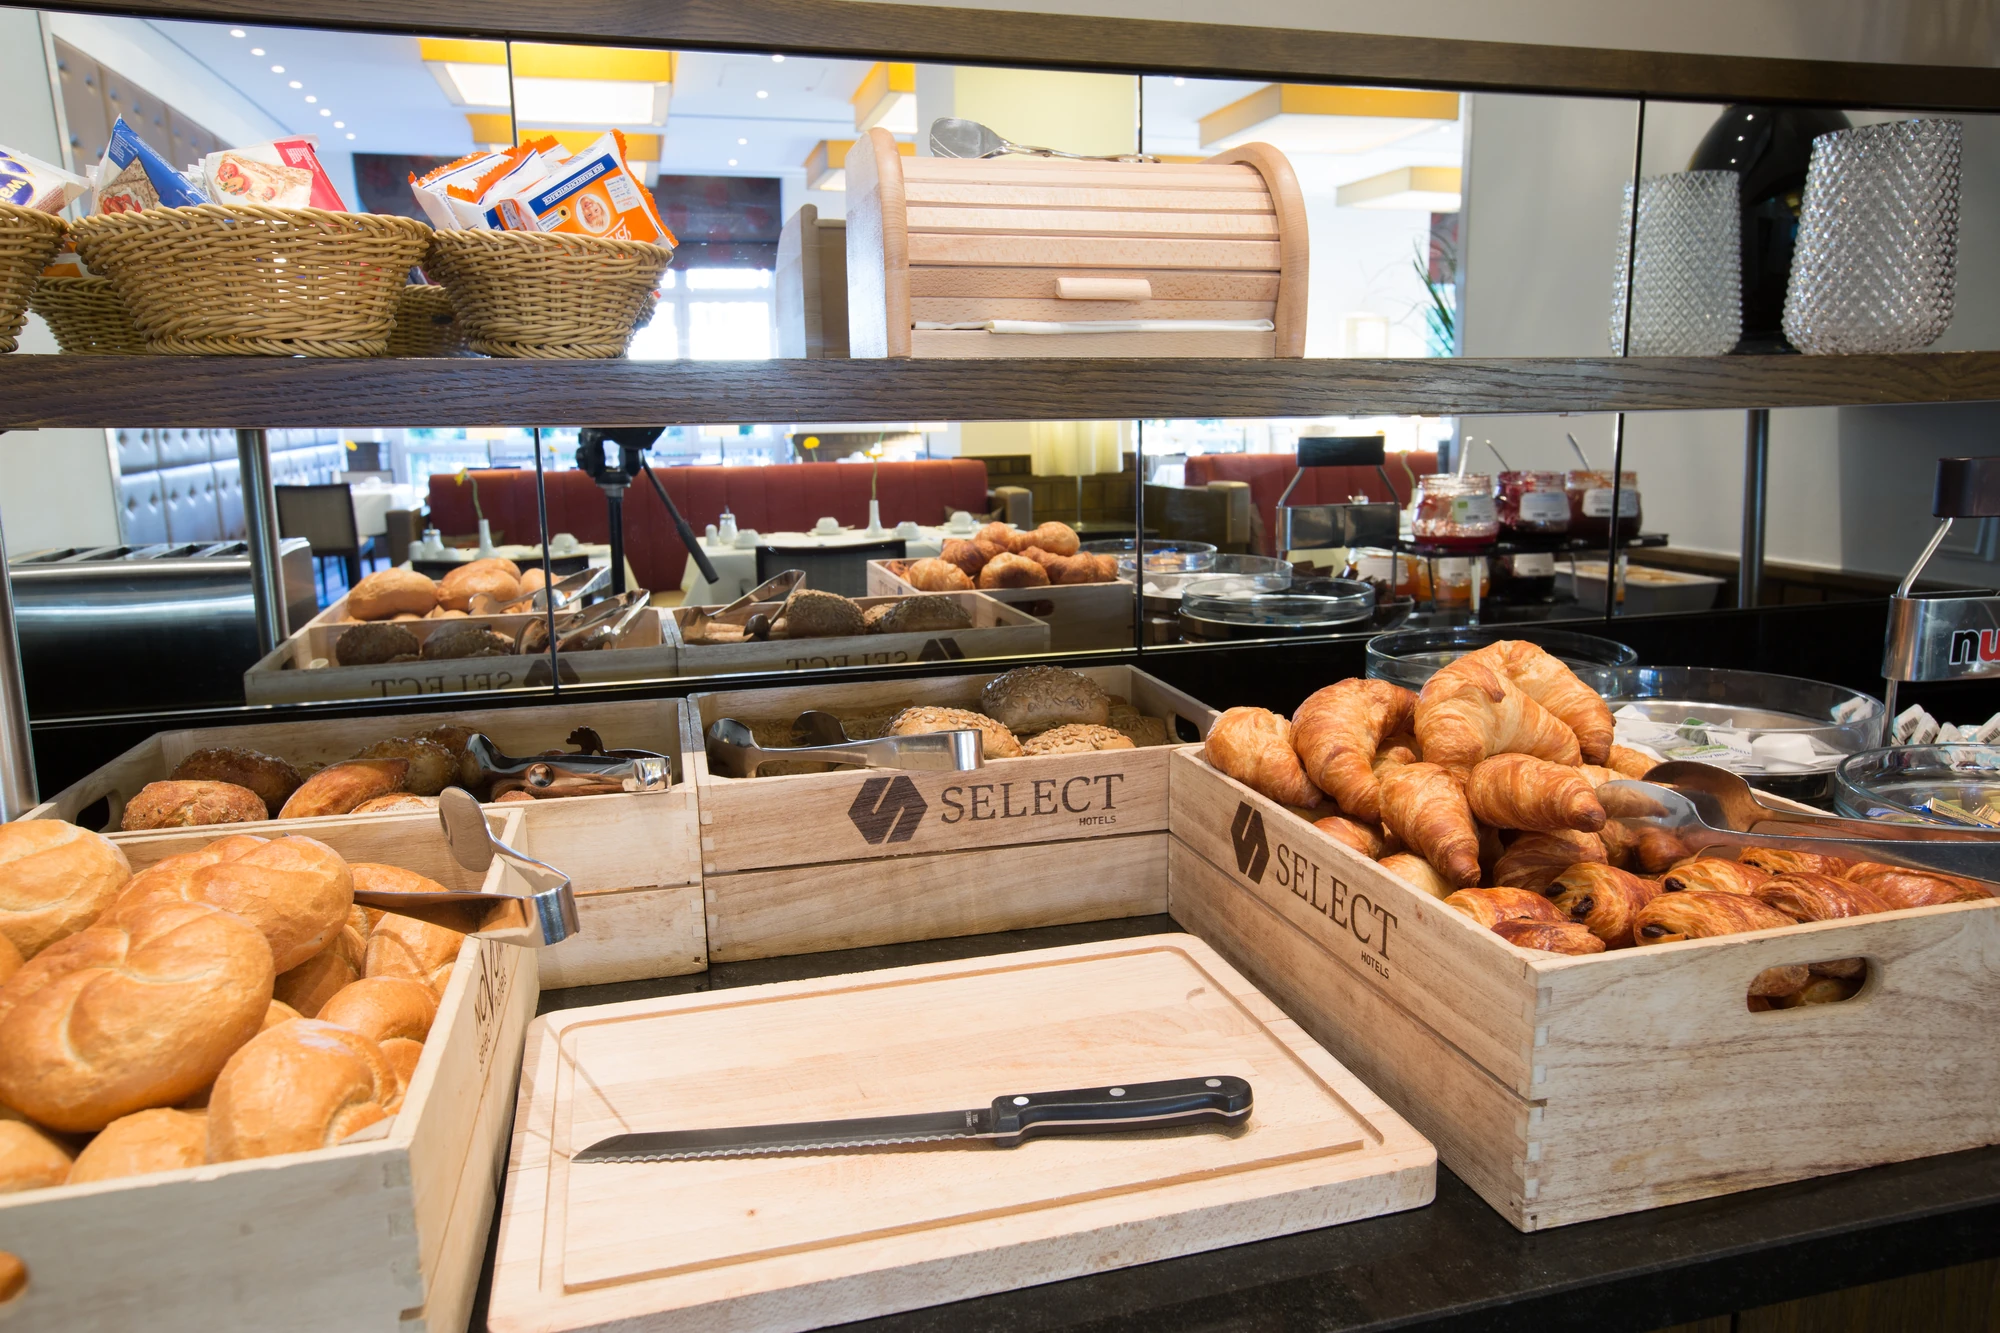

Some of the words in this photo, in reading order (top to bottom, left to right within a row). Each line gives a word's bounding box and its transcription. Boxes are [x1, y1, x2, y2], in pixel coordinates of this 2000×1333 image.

[941, 773, 1124, 824] SELECT
[1079, 815, 1117, 826] HOTELS
[1276, 843, 1398, 961] SELECT
[1361, 950, 1390, 979] HOTELS
